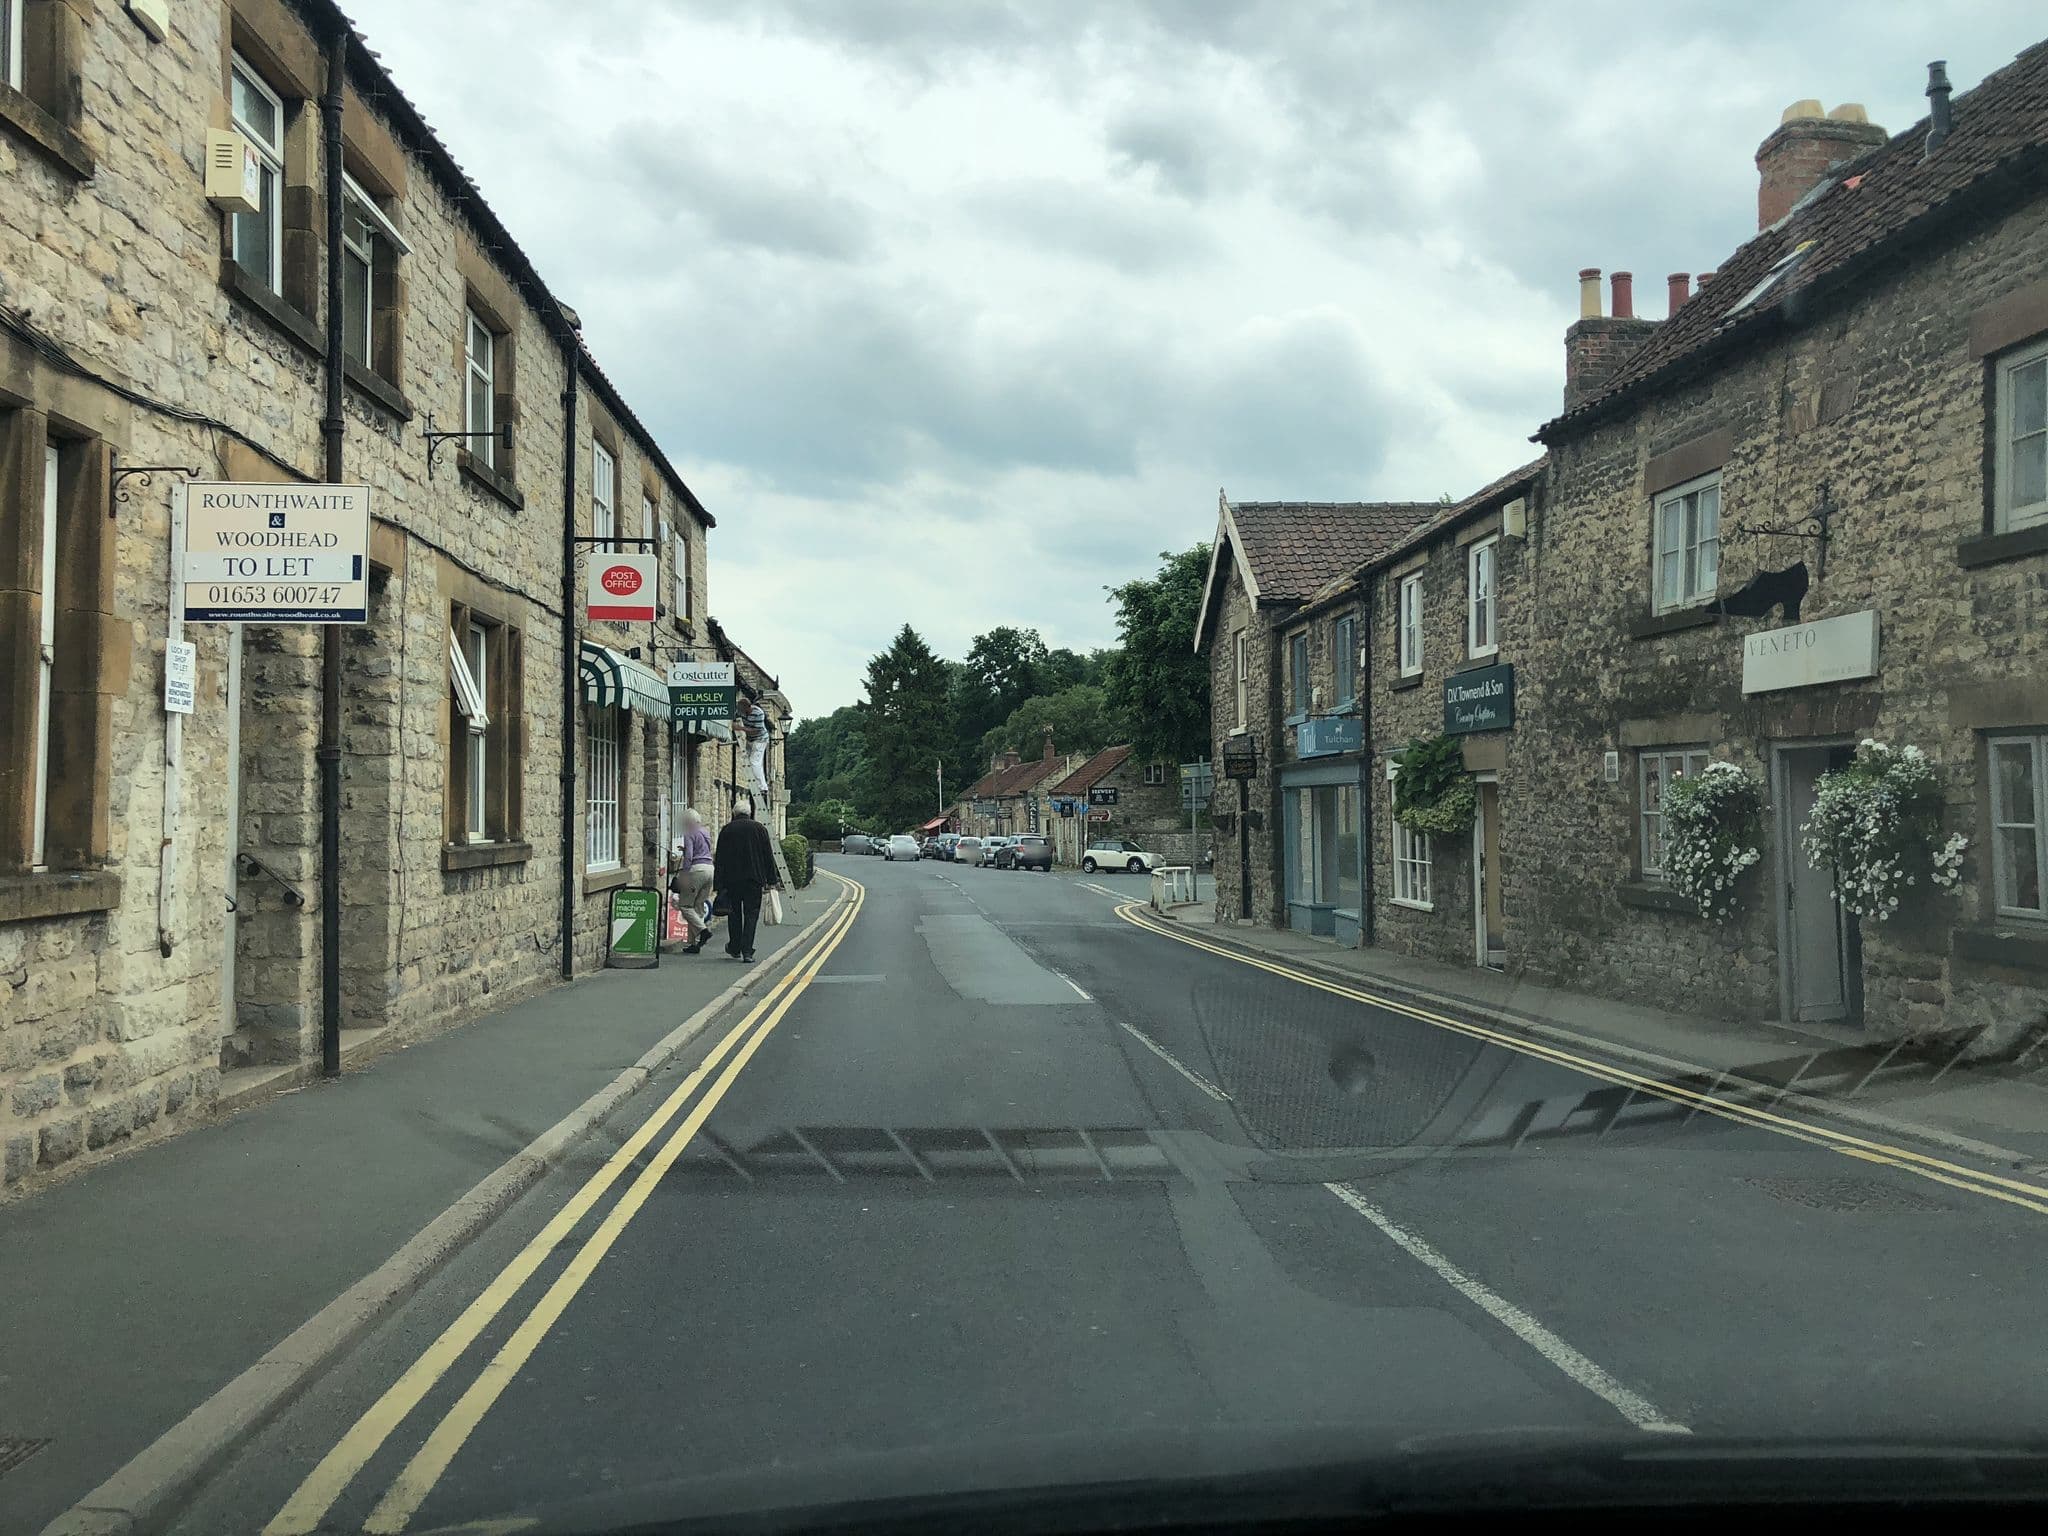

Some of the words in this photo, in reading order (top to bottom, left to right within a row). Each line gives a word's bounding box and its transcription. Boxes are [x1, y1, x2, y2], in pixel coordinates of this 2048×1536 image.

[202, 493, 354, 510] ROUNTHWAITE
[271, 515, 283, 527] &
[215, 531, 338, 547] WOODHEAD
[223, 557, 257, 577] TO
[265, 557, 314, 577] LET
[610, 571, 635, 580] POST
[604, 580, 638, 589] OFFICE
[208, 585, 266, 604] 01653
[272, 586, 341, 604] 600747
[208, 611, 341, 619] www.rounthwaite-woodhead.co.uk
[1749, 629, 1816, 657] VENETO
[672, 669, 729, 681] Costcutter
[1457, 682, 1485, 701] Townend
[1491, 679, 1504, 696] Son
[679, 692, 724, 702] HELMSLEY
[674, 706, 698, 716] OPEN
[700, 706, 706, 716] 7
[707, 706, 729, 716] DAYS
[1324, 735, 1354, 745] Tulchan
[630, 898, 647, 906] cash
